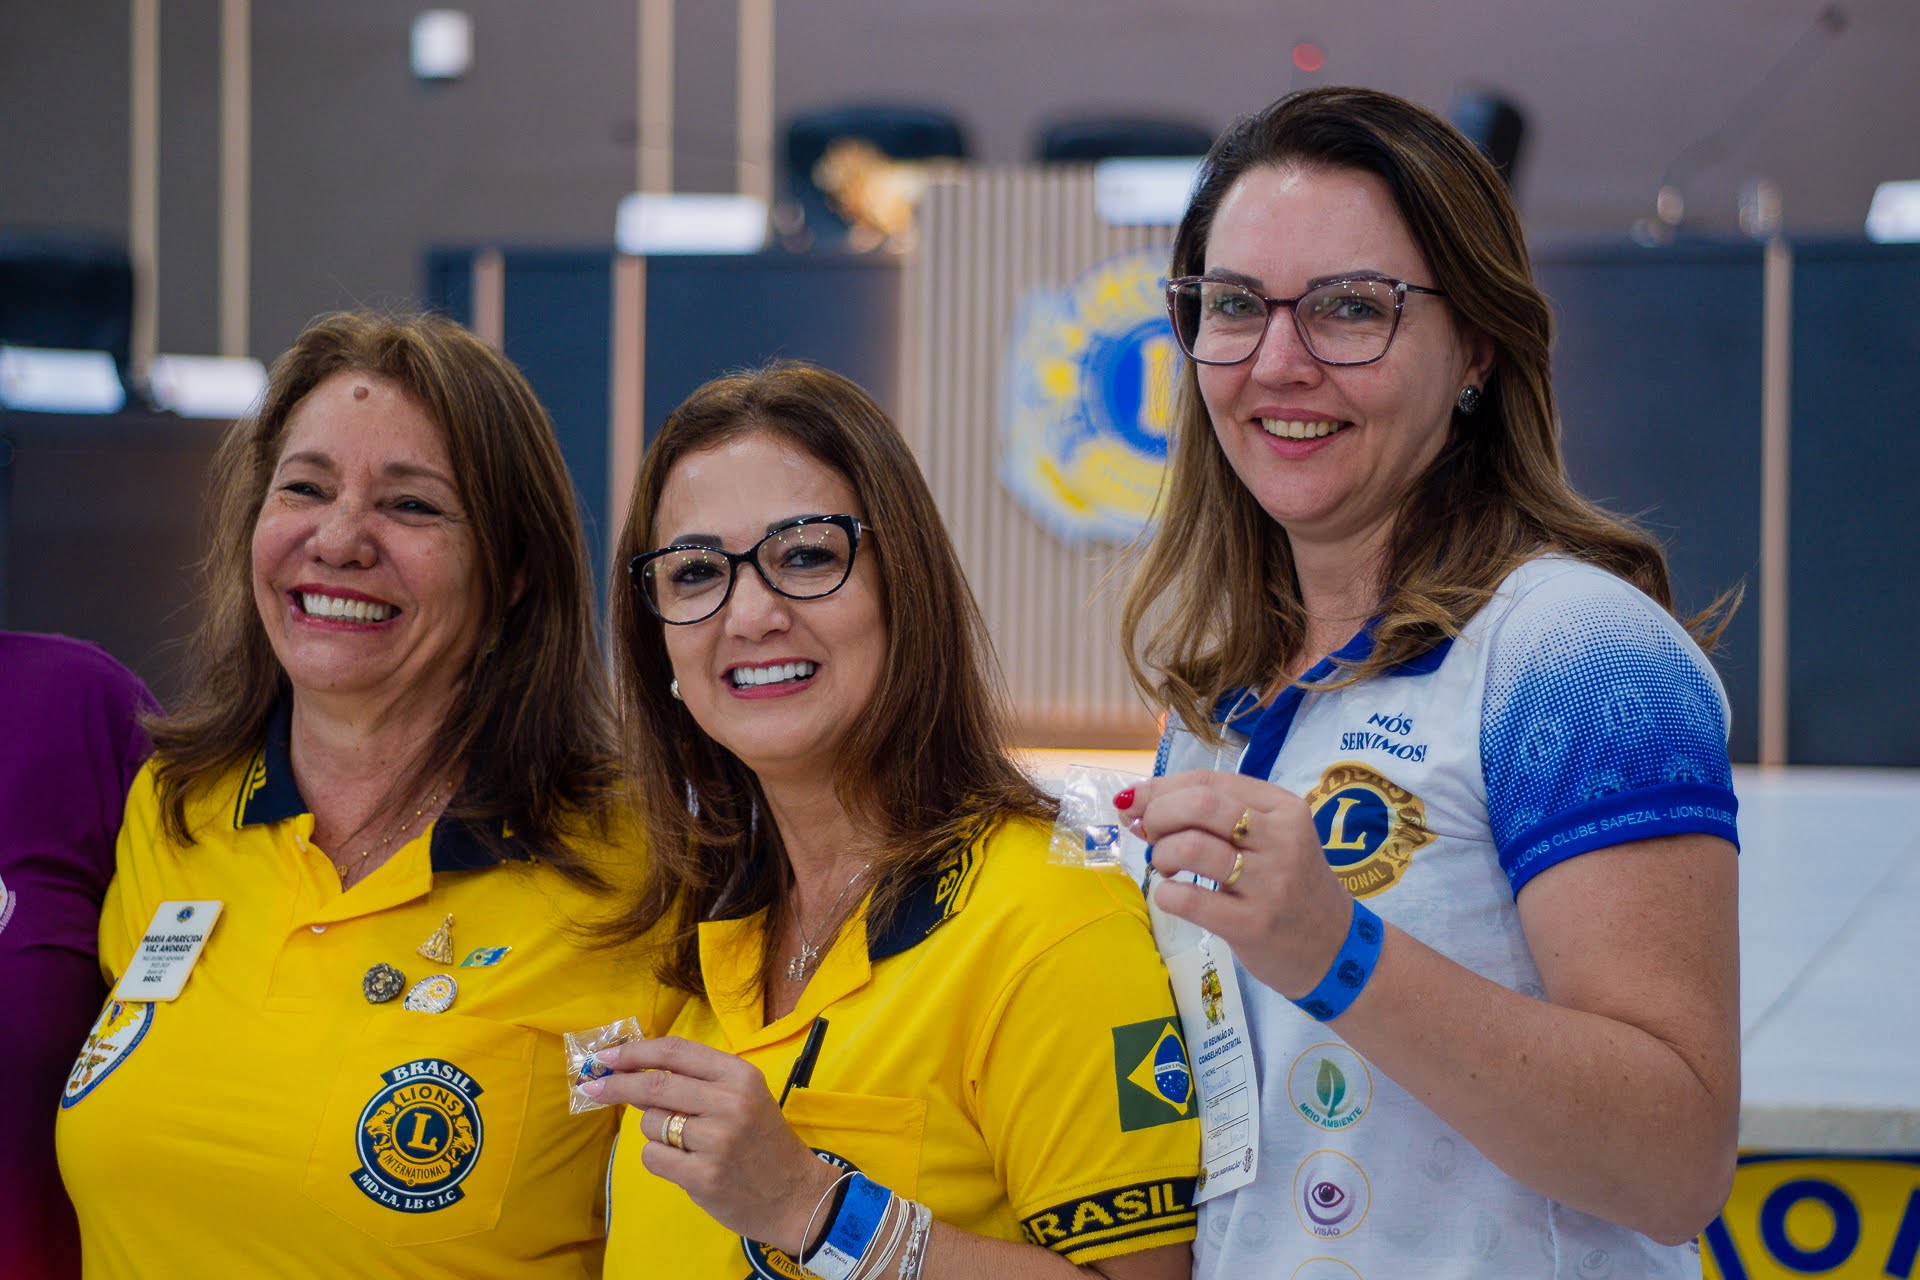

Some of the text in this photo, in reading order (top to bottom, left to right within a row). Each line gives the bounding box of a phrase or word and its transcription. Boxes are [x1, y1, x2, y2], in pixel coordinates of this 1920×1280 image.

[1366, 712, 1413, 736] NÓS
[1340, 732, 1428, 763] SERVIMOS!
[1321, 797, 1367, 850] L
[1517, 840, 1550, 868] LIONS
[1552, 822, 1598, 847] CLUBE
[1600, 809, 1661, 831] SAPEZAL
[1669, 805, 1704, 819] LIONS
[1705, 806, 1734, 826] CLUBE
[1198, 1035, 1242, 1065] CONSELHO DISTRITAL
[1208, 1029, 1228, 1047] REUNIÃO
[1227, 1026, 1234, 1037] DO
[393, 1060, 472, 1092] BRASIL
[399, 1086, 461, 1111] LIONS
[1299, 1102, 1363, 1128] MEIO AMBIENTE
[407, 1112, 438, 1152] L
[382, 1153, 447, 1180] INTERNATIONAL
[358, 1173, 400, 1208] MD-LA,
[404, 1198, 424, 1209] LB
[438, 1190, 457, 1206] LC
[1313, 1226, 1340, 1237] VISÃO
